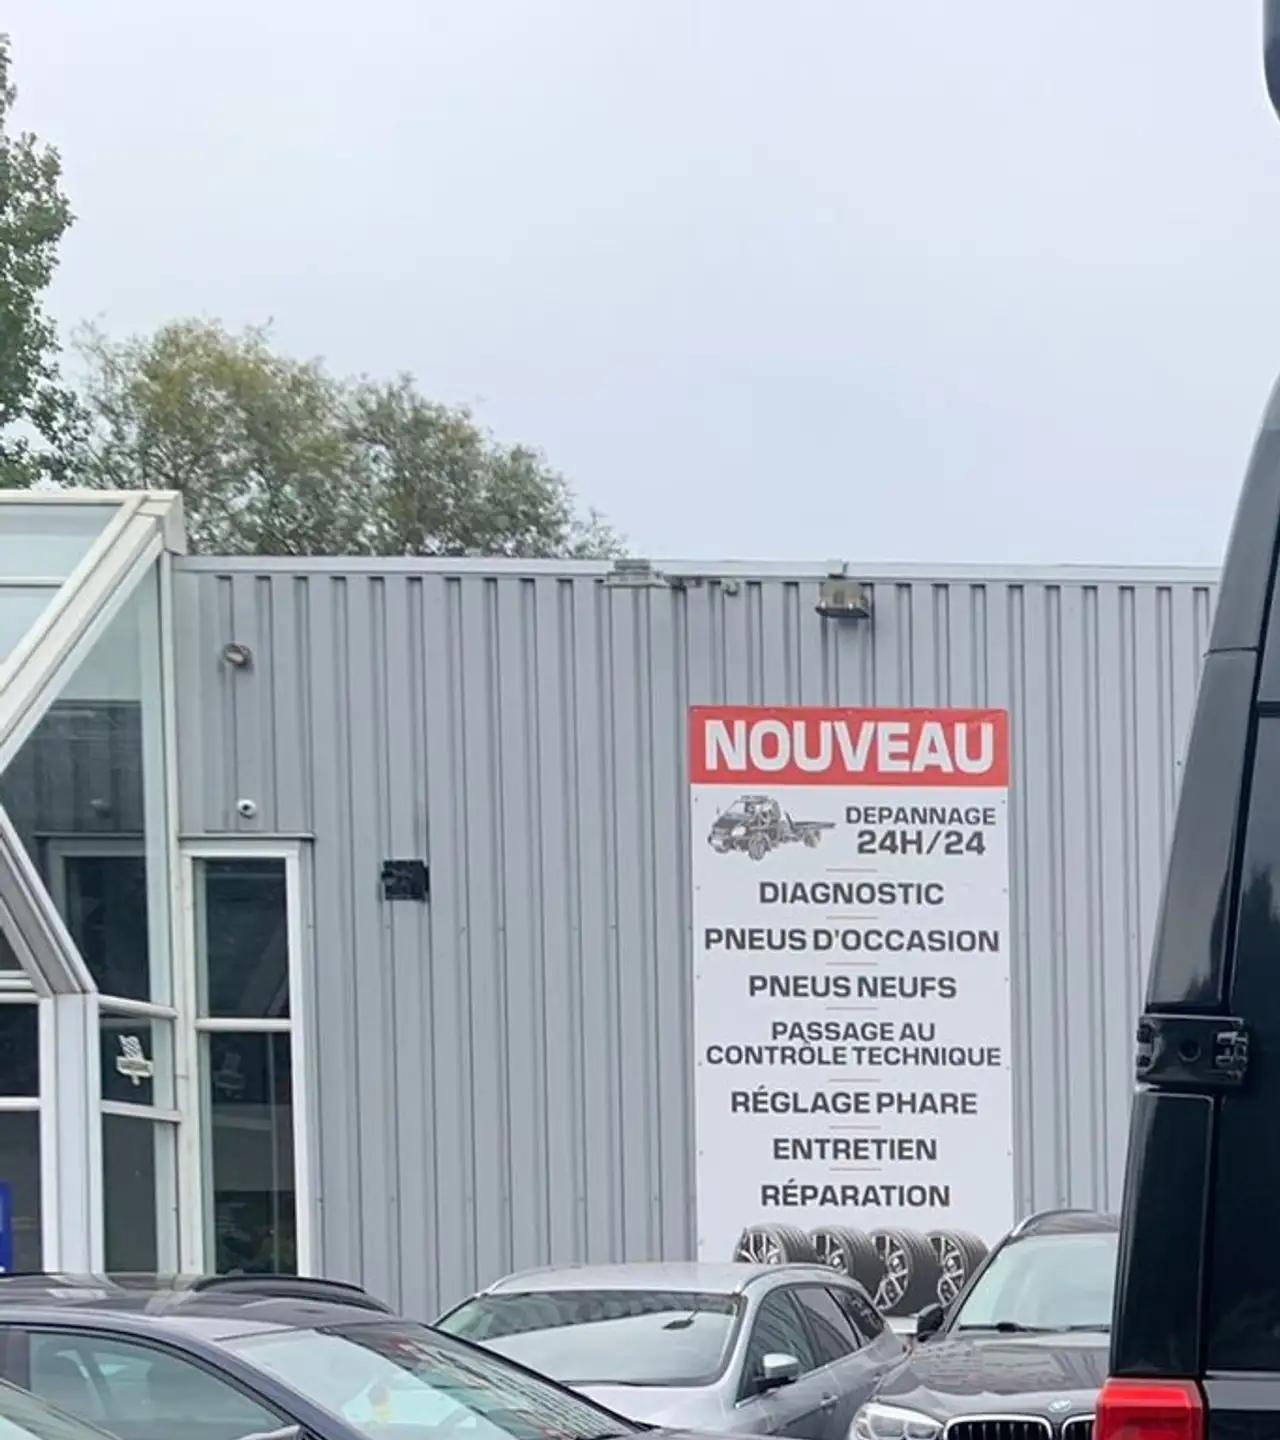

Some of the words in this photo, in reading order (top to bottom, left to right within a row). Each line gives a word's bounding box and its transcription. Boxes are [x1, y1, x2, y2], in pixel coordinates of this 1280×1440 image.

[704, 719, 994, 774] NOUVEAU
[845, 806, 996, 826] DEPANNAGE
[857, 830, 986, 855] 24H/24
[759, 882, 944, 905] DIAGNOSTIC
[704, 928, 807, 951] PNEUS
[813, 929, 999, 952] D'OCCASION
[749, 975, 851, 998] PNEUS
[857, 976, 957, 999] NEUFS
[771, 1021, 894, 1042] PASSAGE
[898, 1022, 936, 1042] AU
[706, 1040, 847, 1066] CONTRÔLE
[851, 1046, 1001, 1067] TECHNIQUE
[731, 1085, 871, 1114] RÉGLAGE
[876, 1092, 978, 1115] PHARE
[773, 1138, 937, 1160] ENTRETIEN
[761, 1178, 950, 1207] RÉPARATION
